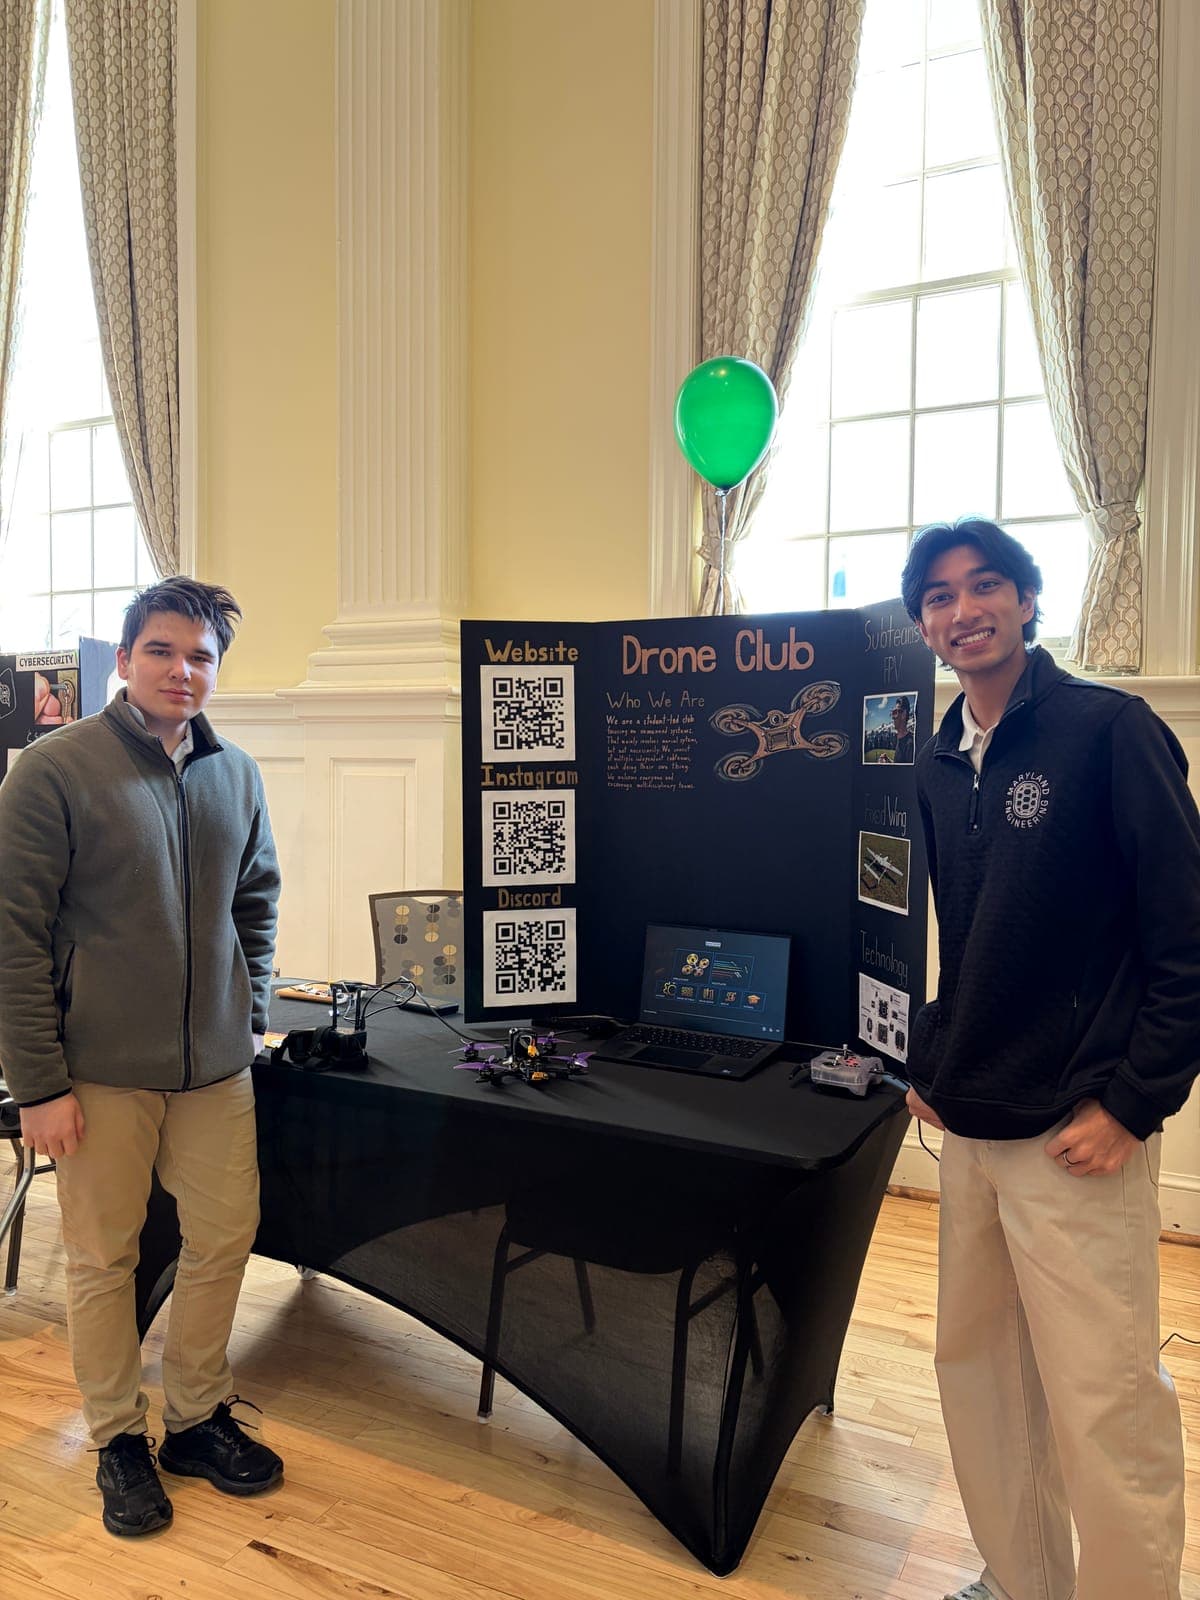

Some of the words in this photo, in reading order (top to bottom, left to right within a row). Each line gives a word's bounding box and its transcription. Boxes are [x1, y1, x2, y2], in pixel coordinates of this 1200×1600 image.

[19, 654, 74, 667] CYBERSECURITY
[483, 638, 579, 662] Website
[622, 635, 717, 675] Drone
[735, 626, 815, 672] Club
[883, 655, 903, 684] FPV
[606, 691, 641, 709] Who
[648, 690, 672, 708] We
[680, 690, 705, 708] Are
[606, 715, 618, 725] We
[682, 714, 695, 724] club
[480, 765, 578, 790] Instagram
[1006, 771, 1050, 796] MARYLAND
[887, 795, 907, 837] Wing
[1004, 799, 1049, 829] ENGINEERING
[498, 886, 562, 908] Discord
[860, 929, 908, 989] Technology
